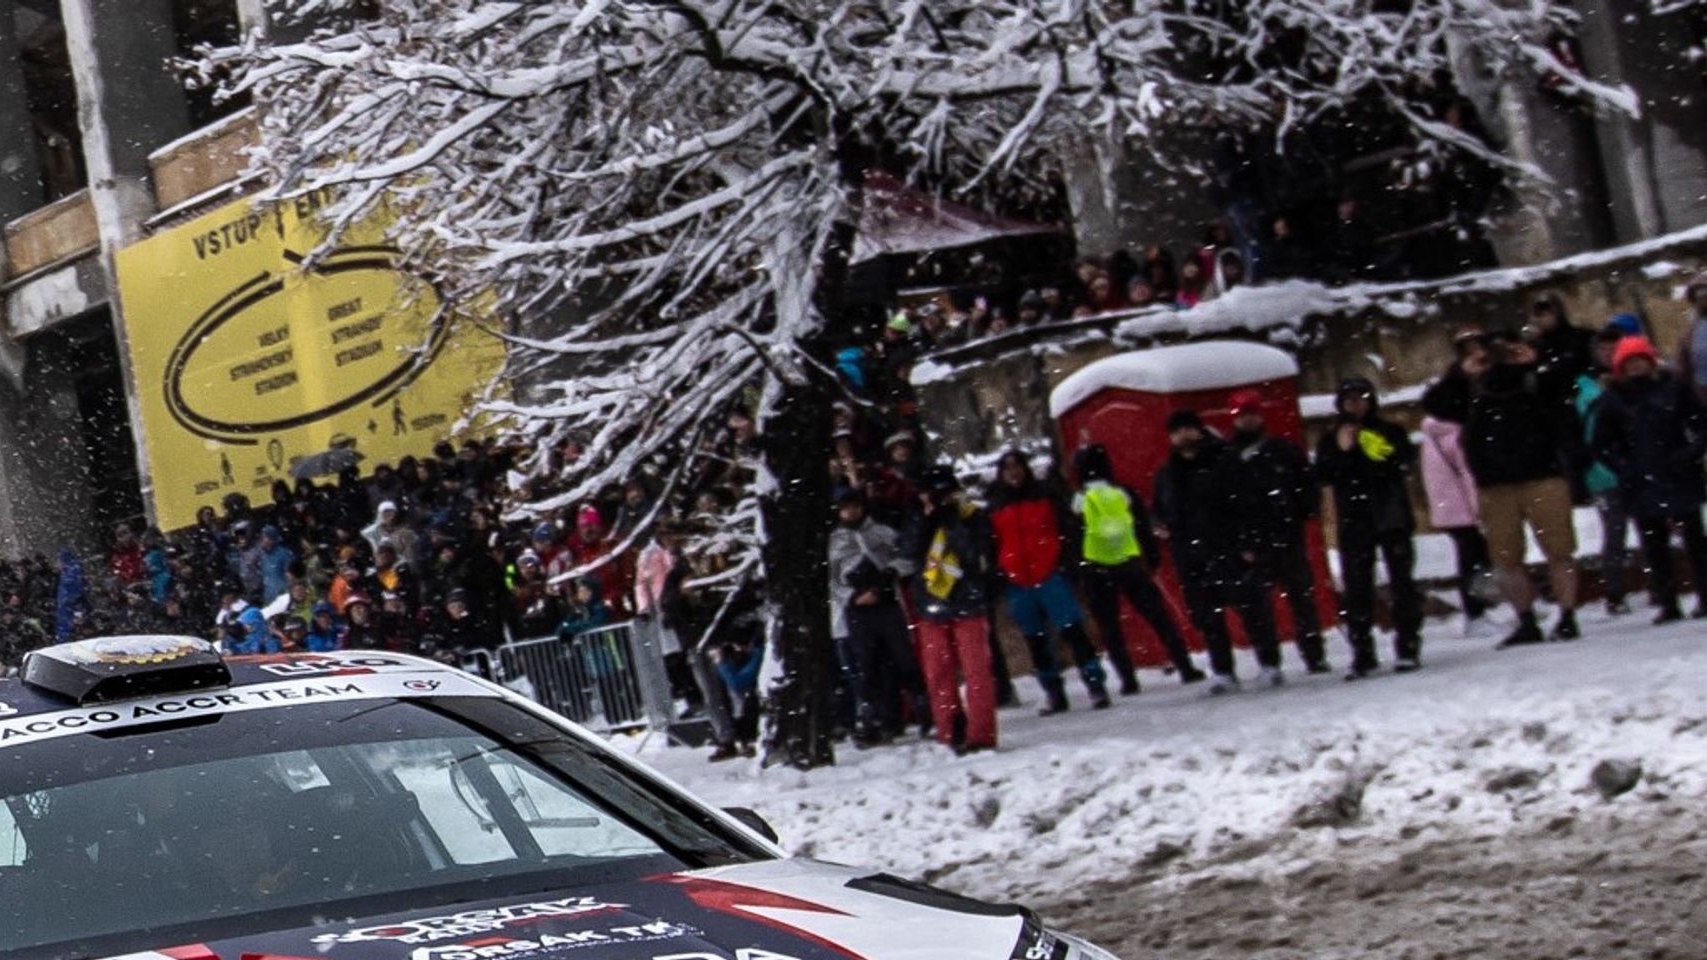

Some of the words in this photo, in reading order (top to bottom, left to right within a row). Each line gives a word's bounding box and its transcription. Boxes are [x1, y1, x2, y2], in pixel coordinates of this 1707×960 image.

[192, 213, 261, 260] VSTUP
[131, 694, 247, 720] ACCR
[247, 682, 364, 702] TEAM
